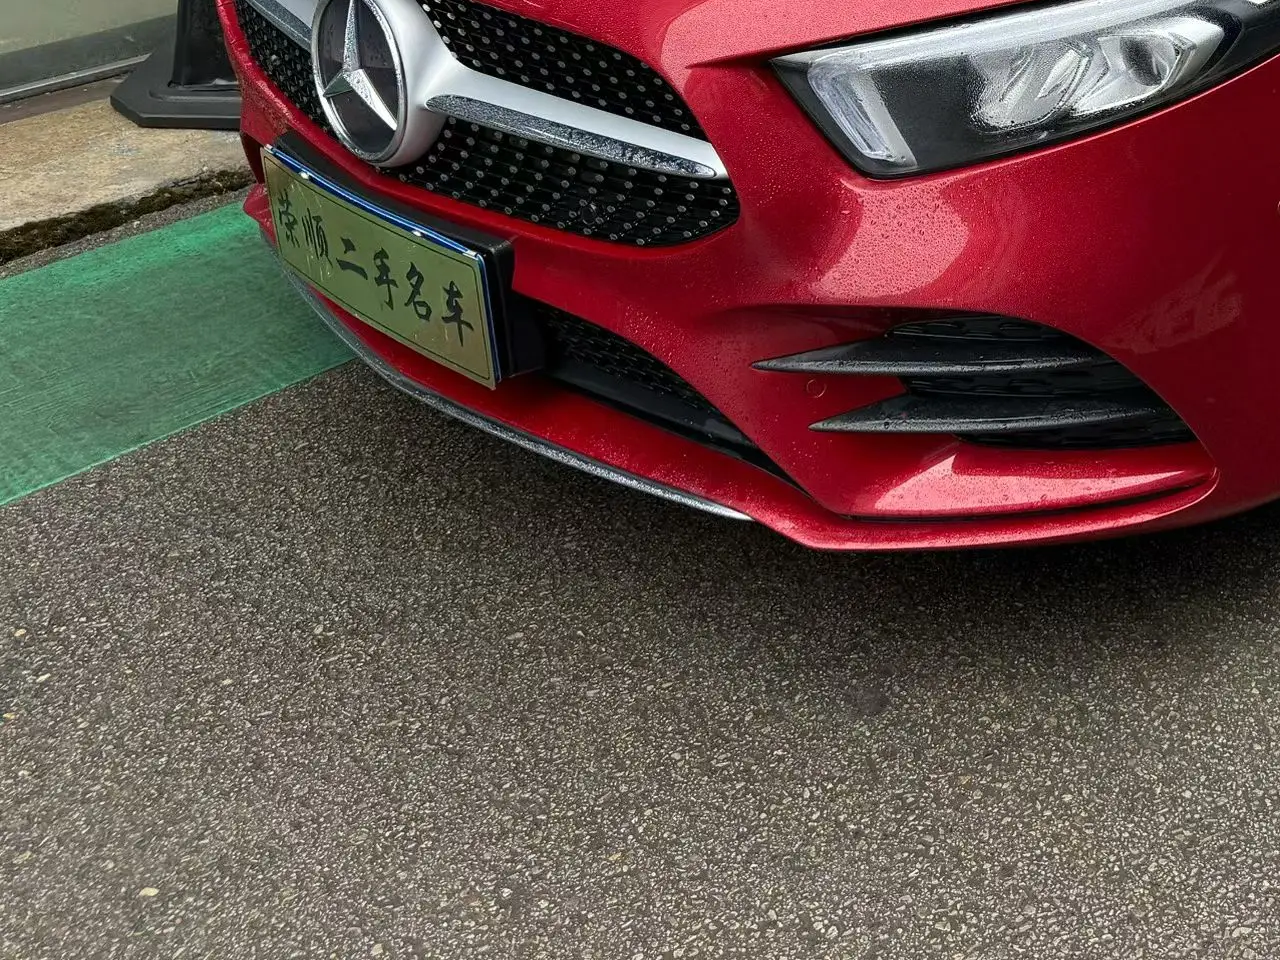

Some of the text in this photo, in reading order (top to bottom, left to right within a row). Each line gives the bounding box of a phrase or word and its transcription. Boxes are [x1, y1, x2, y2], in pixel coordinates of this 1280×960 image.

[277, 188, 474, 347] 荣顺二手名车
